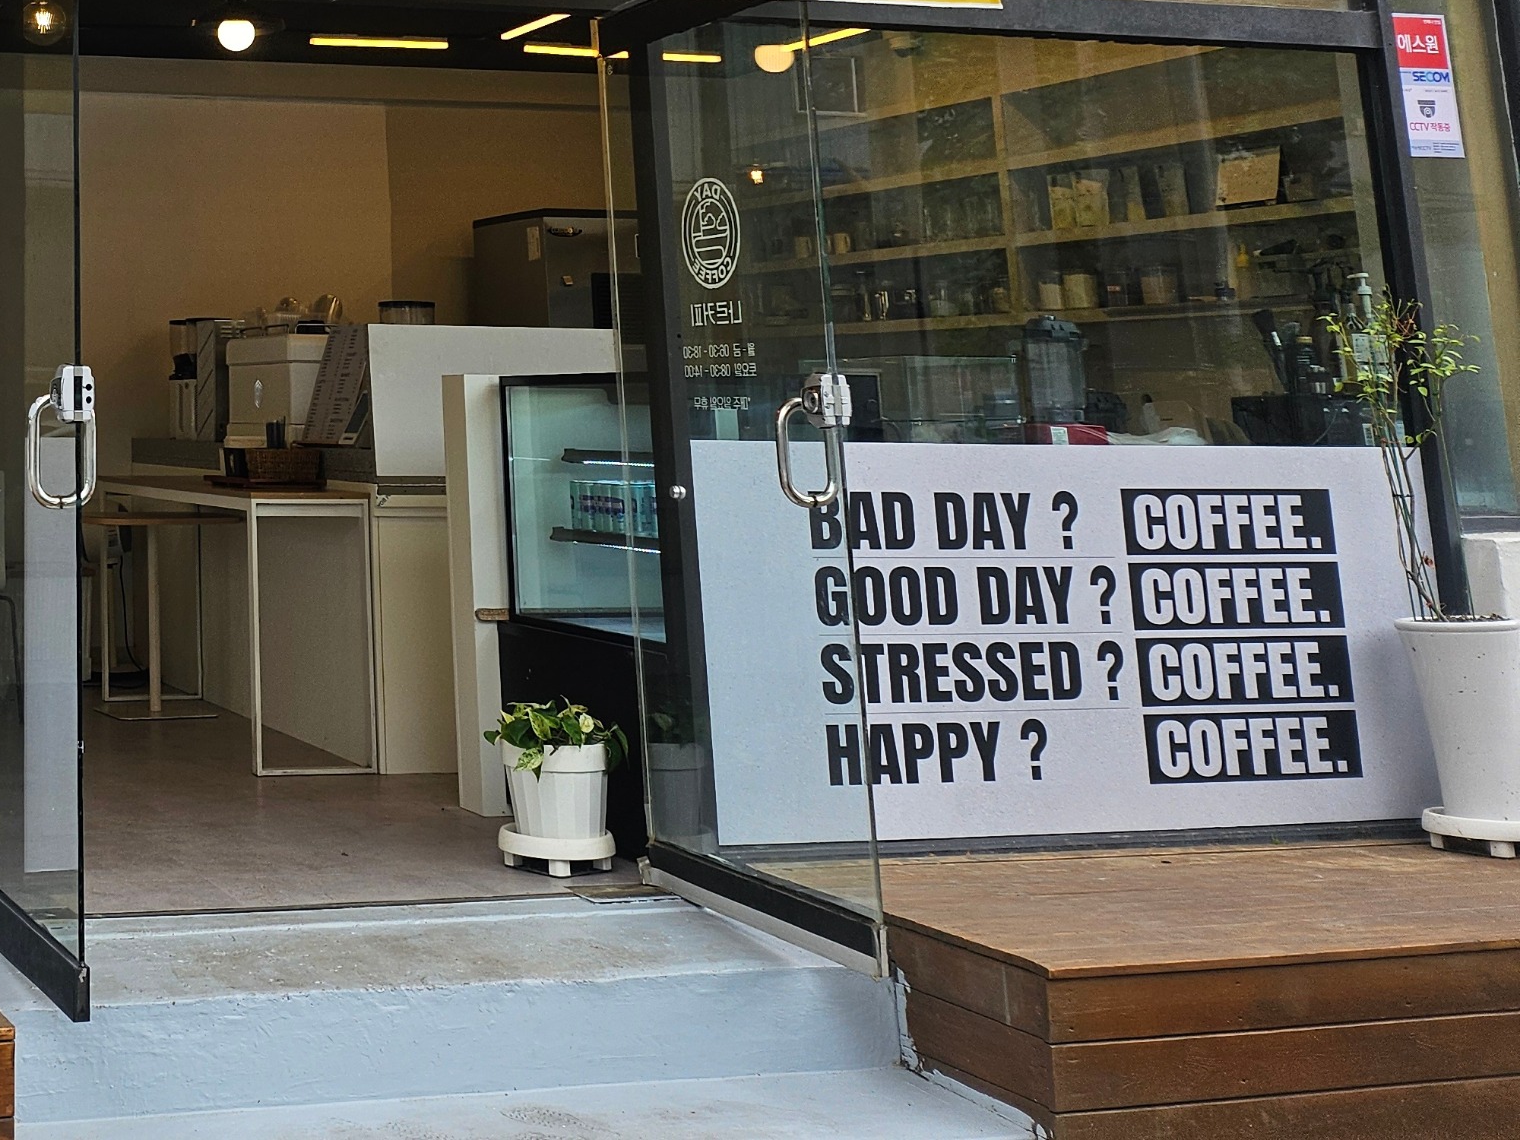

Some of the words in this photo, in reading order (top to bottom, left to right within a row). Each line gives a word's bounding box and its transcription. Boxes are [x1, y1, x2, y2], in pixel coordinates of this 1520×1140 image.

[1397, 33, 1440, 54] 에스원
[1412, 71, 1451, 83] SECOM
[1409, 122, 1430, 132] CCTV
[1430, 122, 1451, 133] 작동중
[809, 490, 916, 550] BAD
[935, 490, 1031, 550] DAY
[1051, 490, 1079, 550] ?
[1132, 493, 1322, 552] COFFEE.
[813, 565, 958, 627] GOOD
[977, 564, 1076, 625] DAY
[1089, 564, 1117, 625] ?
[1140, 566, 1330, 627] COFFEE.
[821, 640, 1082, 706] STRESSED
[1096, 639, 1125, 701] ?
[1147, 640, 1339, 701] COFFEE.
[826, 720, 1001, 786] HAPPY
[1019, 717, 1048, 781] ?
[1157, 715, 1348, 778] COFFEE.
